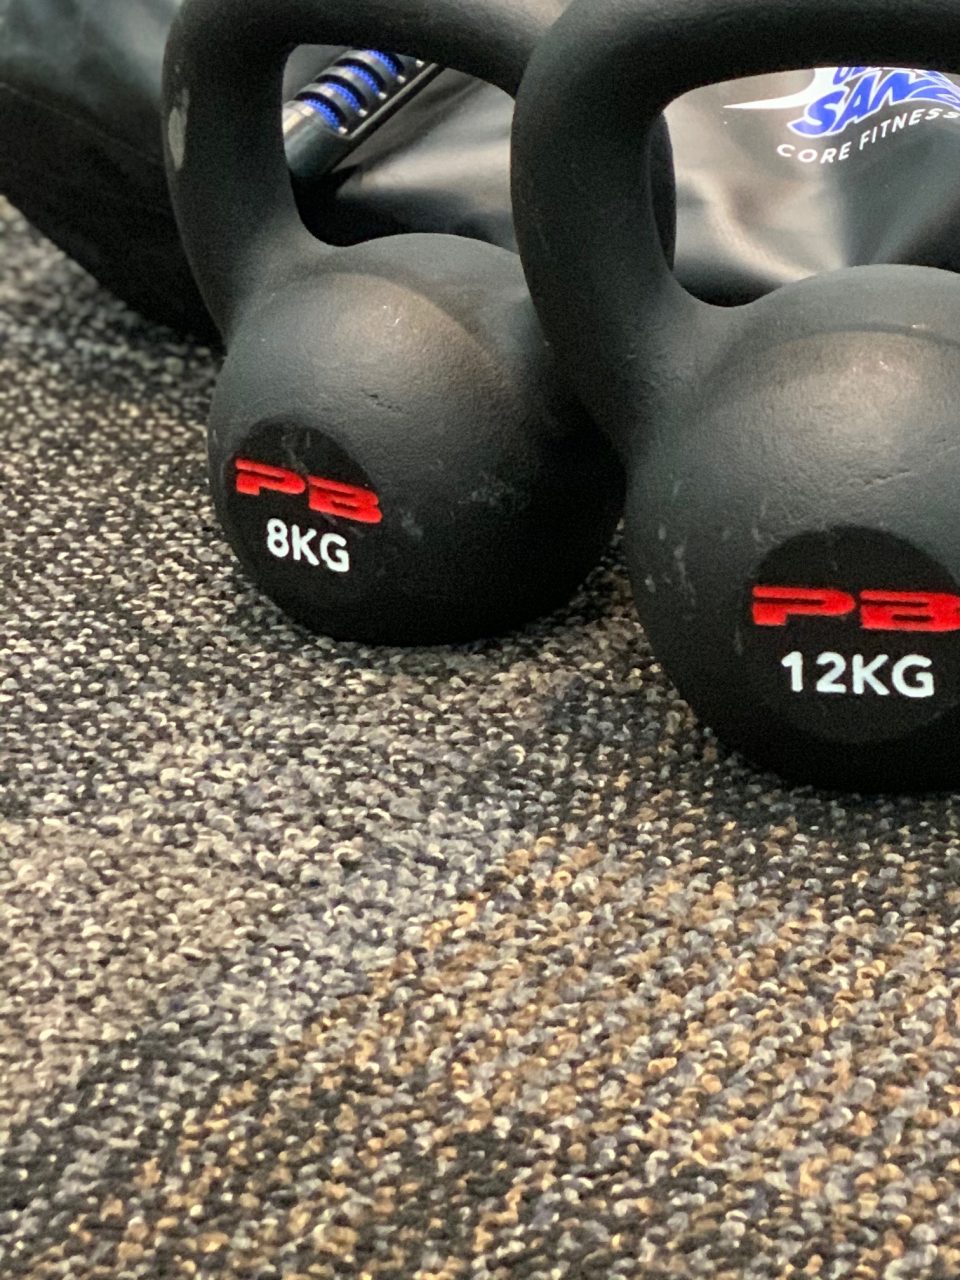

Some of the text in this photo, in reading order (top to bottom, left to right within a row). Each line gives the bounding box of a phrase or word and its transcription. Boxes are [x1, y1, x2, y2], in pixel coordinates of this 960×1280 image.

[776, 141, 852, 165] CORE
[235, 457, 383, 524] PB
[266, 517, 350, 573] 8KG
[780, 650, 935, 698] 12KG
